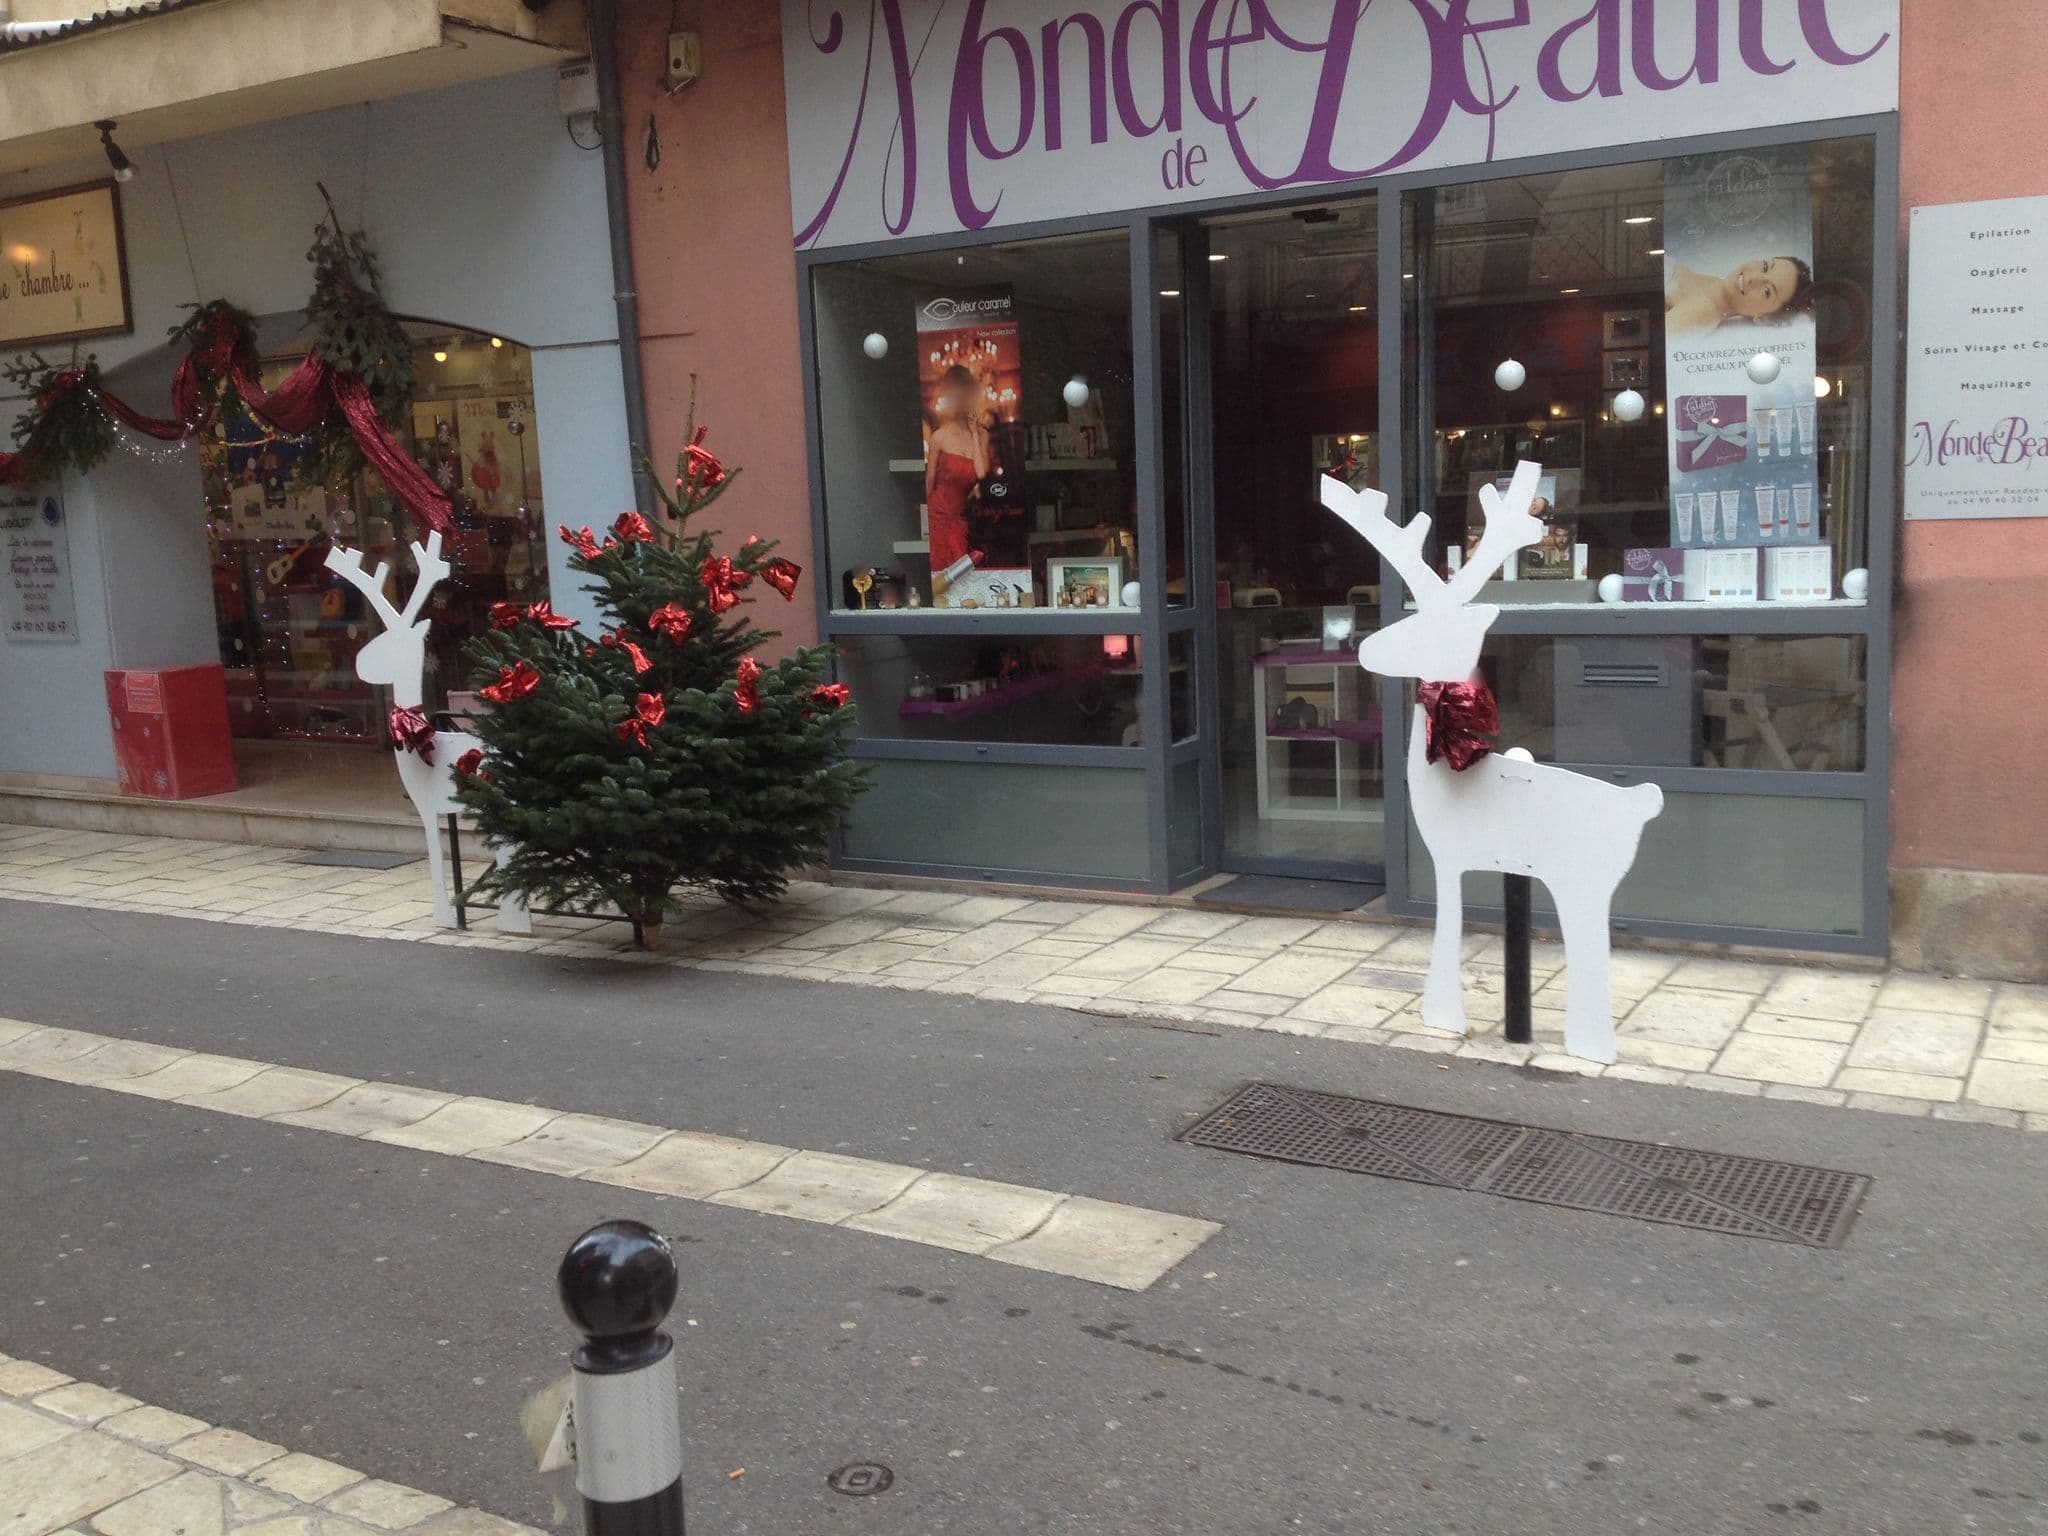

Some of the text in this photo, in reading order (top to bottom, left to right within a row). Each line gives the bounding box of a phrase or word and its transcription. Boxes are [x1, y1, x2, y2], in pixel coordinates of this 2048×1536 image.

[1162, 138, 1209, 190] de
[1970, 228, 2031, 240] Epilation
[1970, 266, 2028, 278] Onglerie
[978, 294, 1012, 312] caramel
[1971, 305, 2024, 315] Massage
[1924, 346, 1959, 355] Soins
[1965, 343, 2007, 353] Visage
[2013, 342, 2026, 350] et
[1686, 360, 1736, 374] CADEAUX
[1961, 379, 2032, 391] Maquillage
[1904, 418, 1996, 471] Monde
